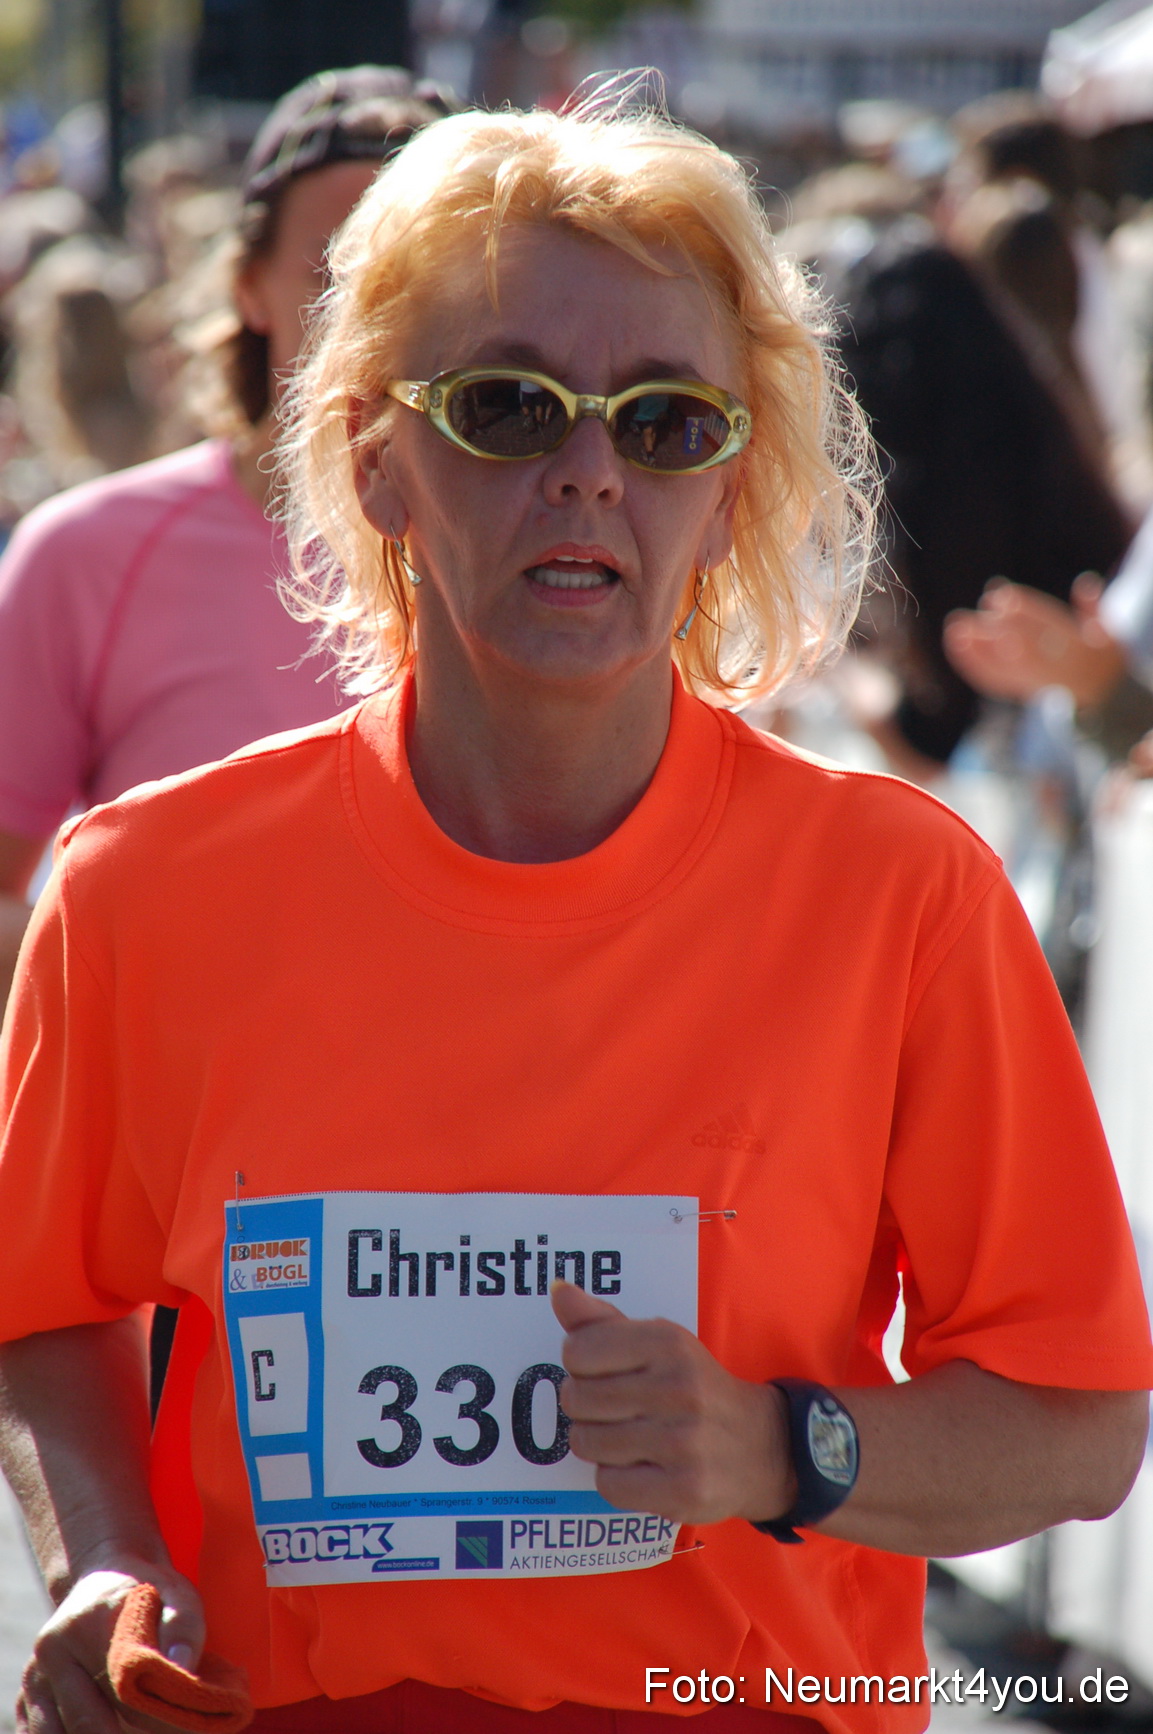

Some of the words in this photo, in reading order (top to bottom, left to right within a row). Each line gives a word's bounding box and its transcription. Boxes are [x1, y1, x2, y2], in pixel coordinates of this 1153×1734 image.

[231, 1240, 308, 1262] DRUCK
[347, 1228, 622, 1297] Christine
[230, 1268, 248, 1291] &
[256, 1264, 308, 1283] BÖGL
[251, 1349, 276, 1402] C
[356, 1363, 573, 1469] 330
[331, 1500, 367, 1511] Christine
[369, 1498, 411, 1509] Neubauer
[477, 1497, 483, 1506] 9
[492, 1496, 520, 1505] 90574
[522, 1496, 557, 1505] Rosstal
[263, 1522, 394, 1565] BOCK
[510, 1515, 674, 1550] PFLEIDERER
[377, 1560, 435, 1570] www.bockonline.de
